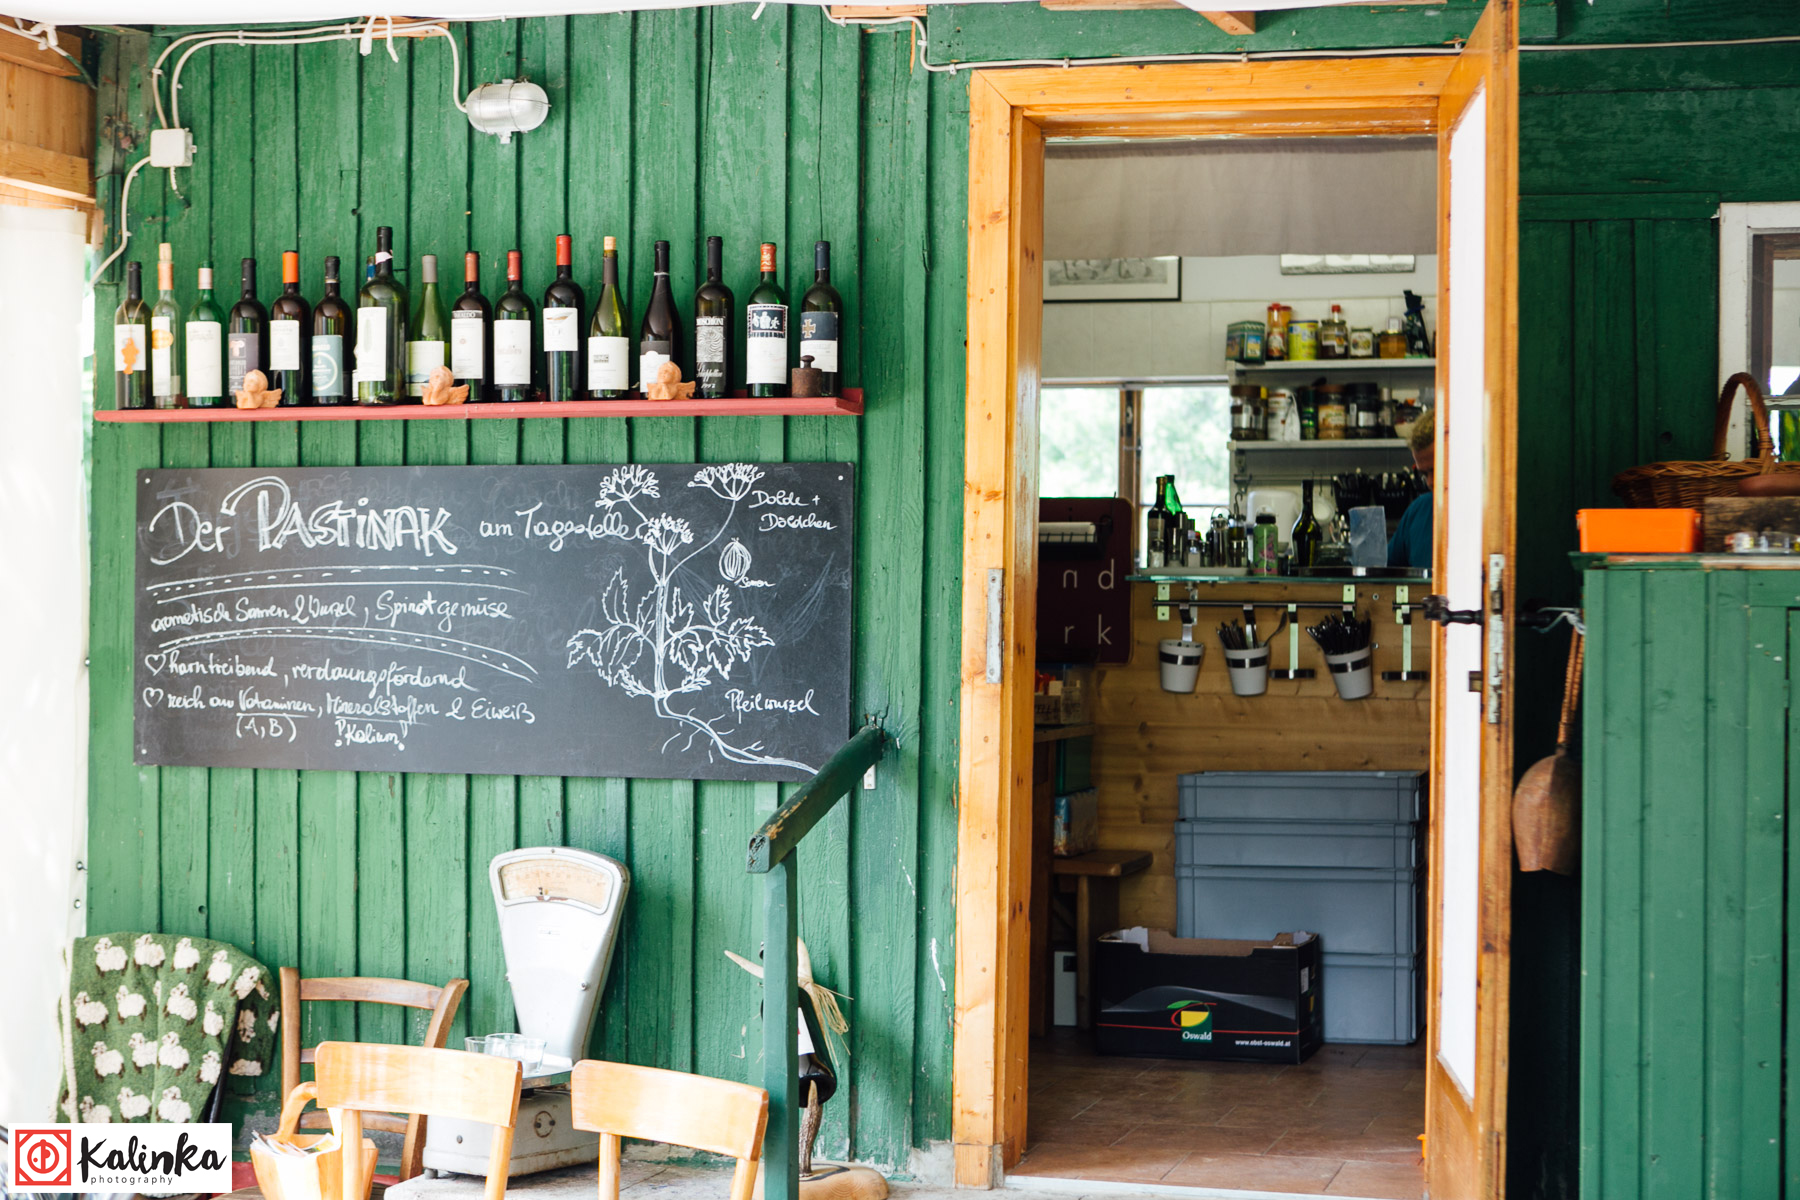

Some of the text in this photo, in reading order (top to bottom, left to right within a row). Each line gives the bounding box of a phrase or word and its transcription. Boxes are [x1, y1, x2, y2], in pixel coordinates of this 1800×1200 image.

[149, 501, 231, 565] Der
[479, 520, 514, 538] am
[1182, 1031, 1212, 1041] Oswald
